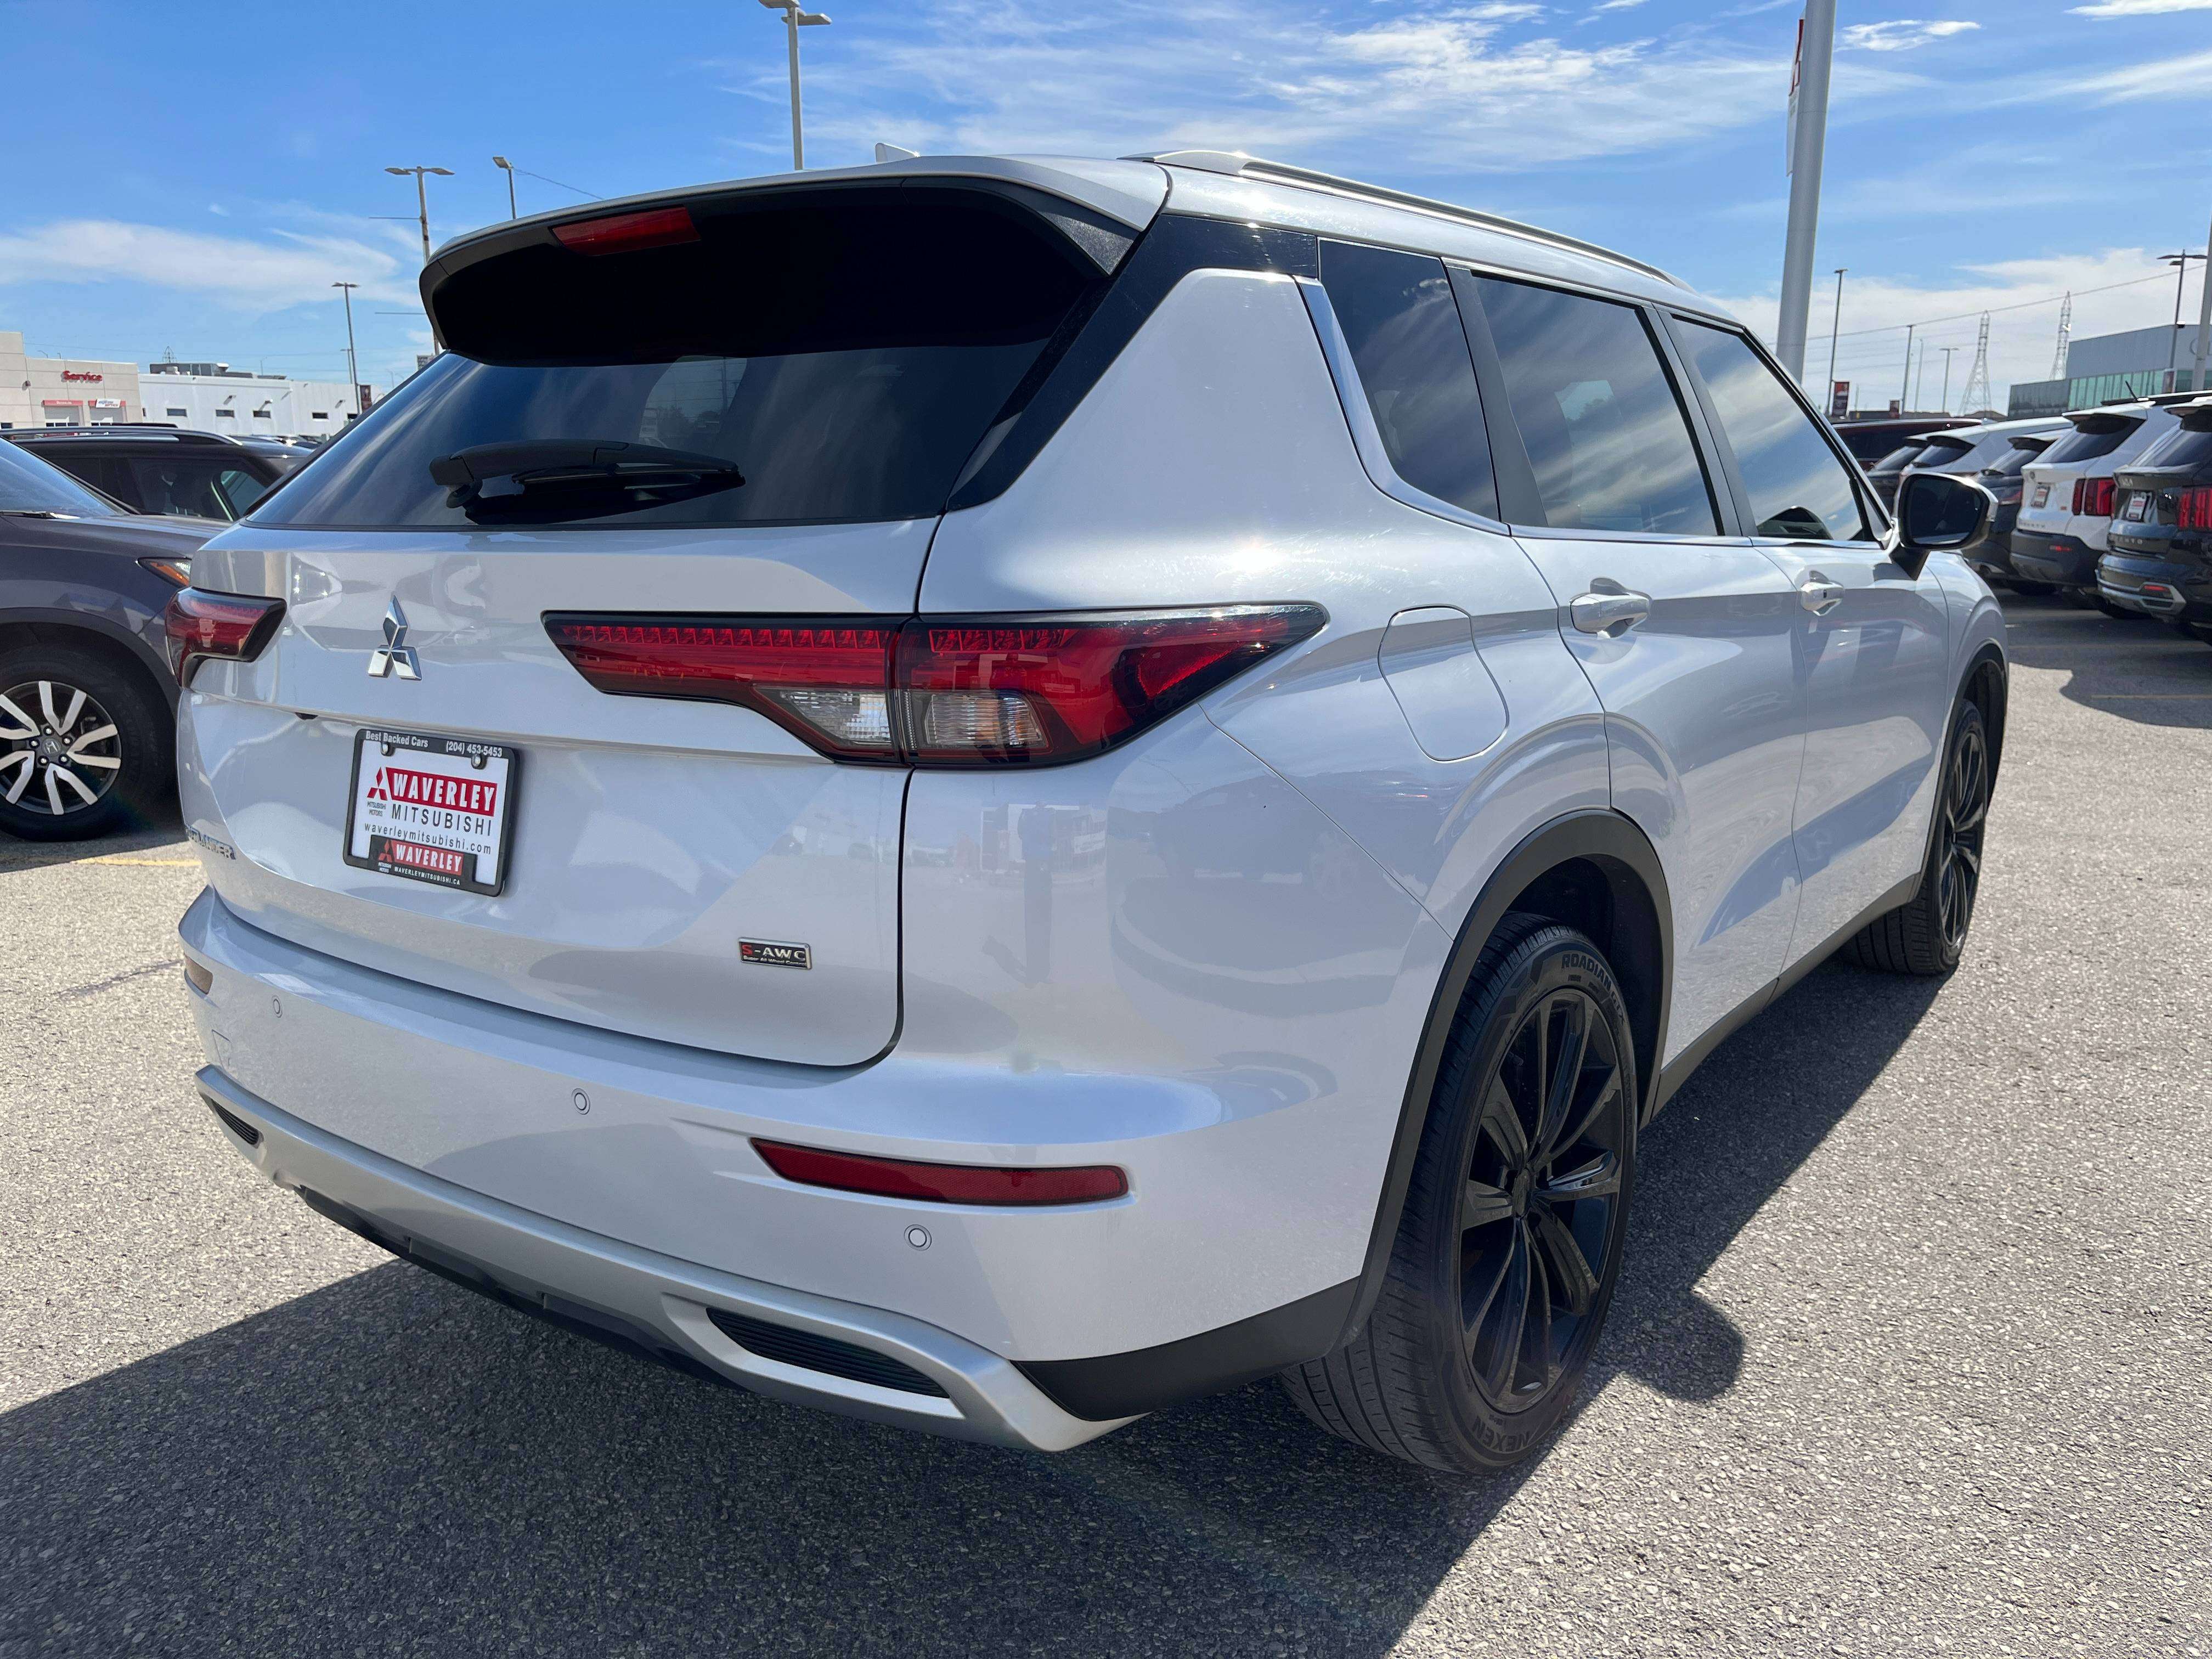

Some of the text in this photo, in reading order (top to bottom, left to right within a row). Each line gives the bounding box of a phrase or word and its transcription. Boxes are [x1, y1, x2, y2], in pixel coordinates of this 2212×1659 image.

[61, 370, 103, 382] Service
[366, 730, 503, 758] Best Backed Cars (204) 453-5453
[393, 772, 495, 811] WAVERLEY
[392, 803, 492, 836] MITSUBISHI
[364, 822, 492, 855] waverleymitsubishi.com
[396, 844, 462, 872] WAVERLEY
[394, 866, 460, 885] WAVERLEYMITSUBISHI.CA
[742, 944, 806, 961] S-AWC
[1561, 953, 1612, 992] ROADIAN
[1472, 1415, 1530, 1452] NEXEN
